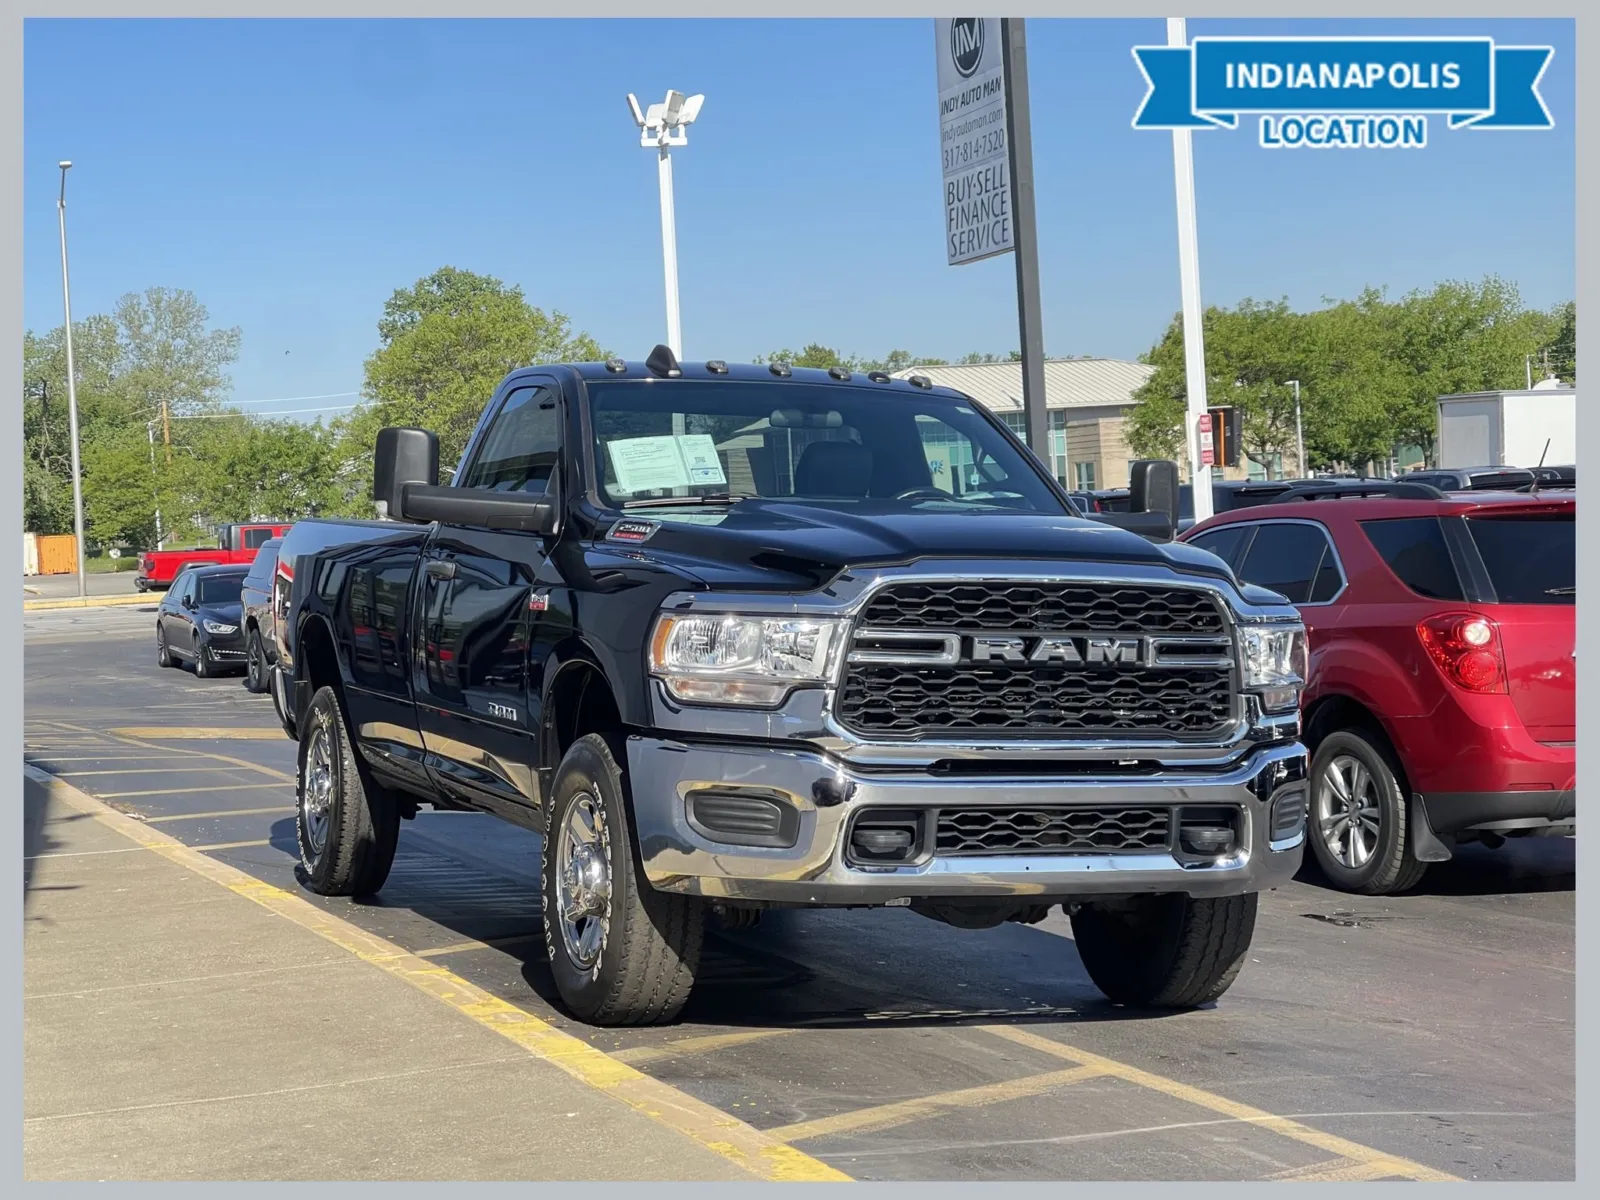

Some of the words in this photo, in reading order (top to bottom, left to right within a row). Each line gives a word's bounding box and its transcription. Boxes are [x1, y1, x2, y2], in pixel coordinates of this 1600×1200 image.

[941, 95, 960, 116] INDY
[960, 85, 981, 108] AUTO
[982, 76, 1002, 98] MAN
[942, 108, 1003, 143] indyautoman.com
[948, 190, 1008, 232] FINANCE
[950, 218, 1009, 258] SERVICE
[973, 636, 1139, 663] RAM
